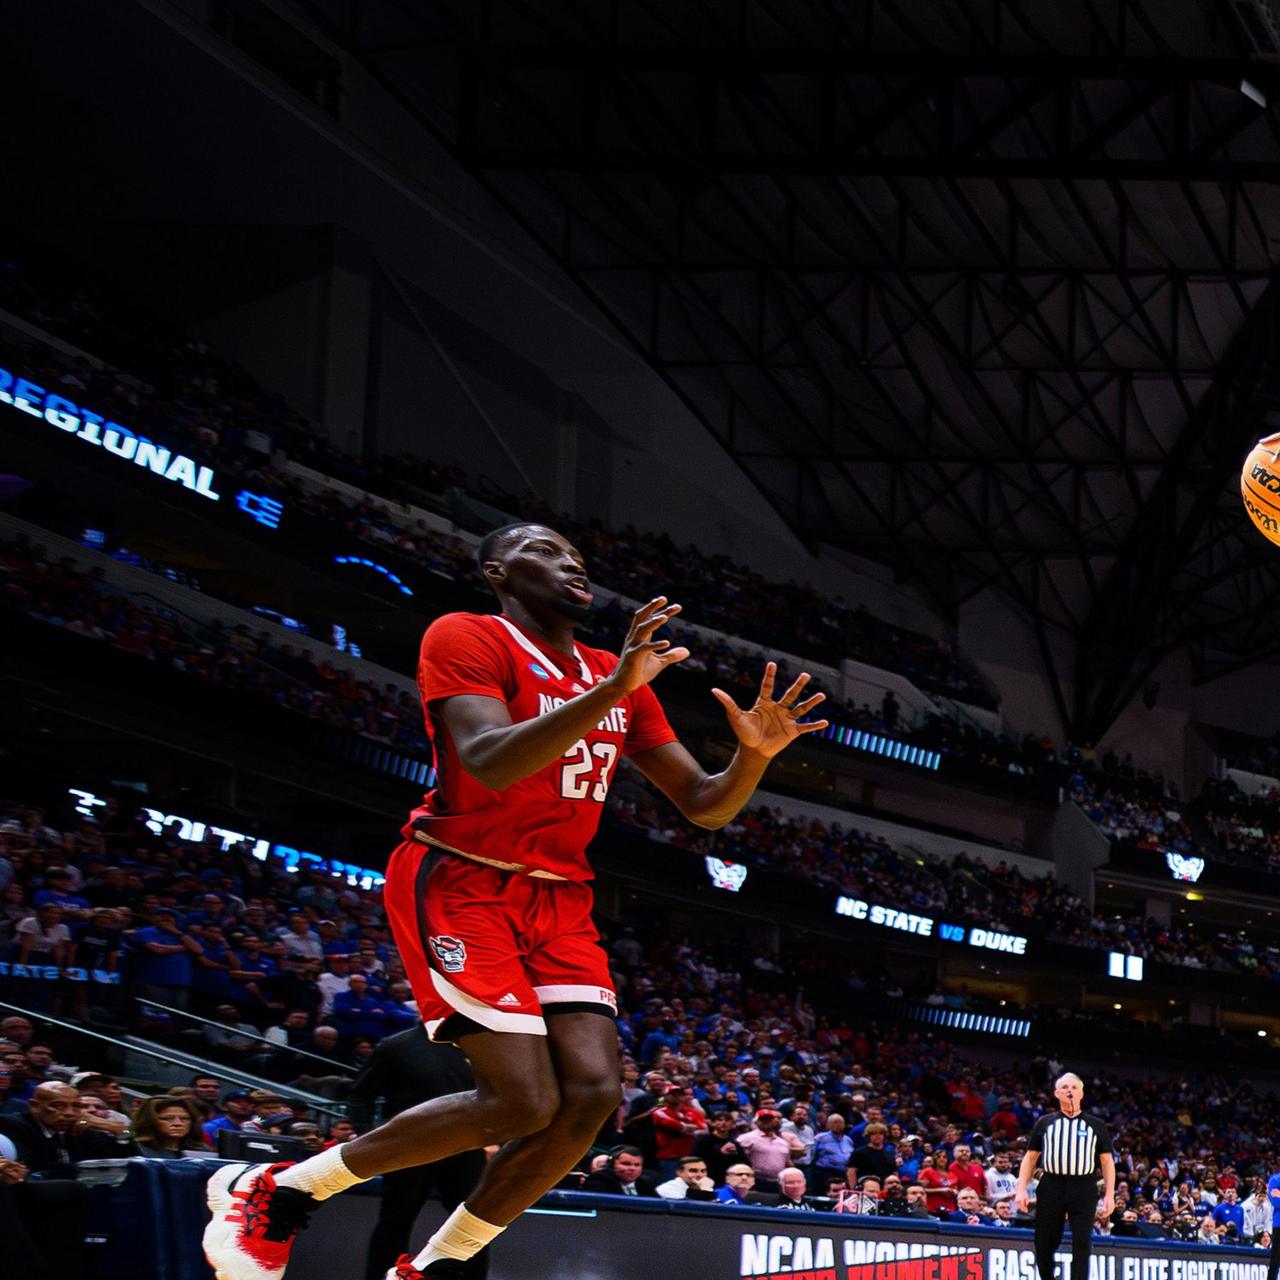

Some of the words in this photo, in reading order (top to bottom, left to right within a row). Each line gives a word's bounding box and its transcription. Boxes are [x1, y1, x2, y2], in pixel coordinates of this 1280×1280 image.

[561, 738, 618, 802] 23
[836, 896, 868, 919] NC
[869, 905, 934, 936] STATE
[939, 922, 965, 942] VS
[969, 928, 1028, 955] DUKE
